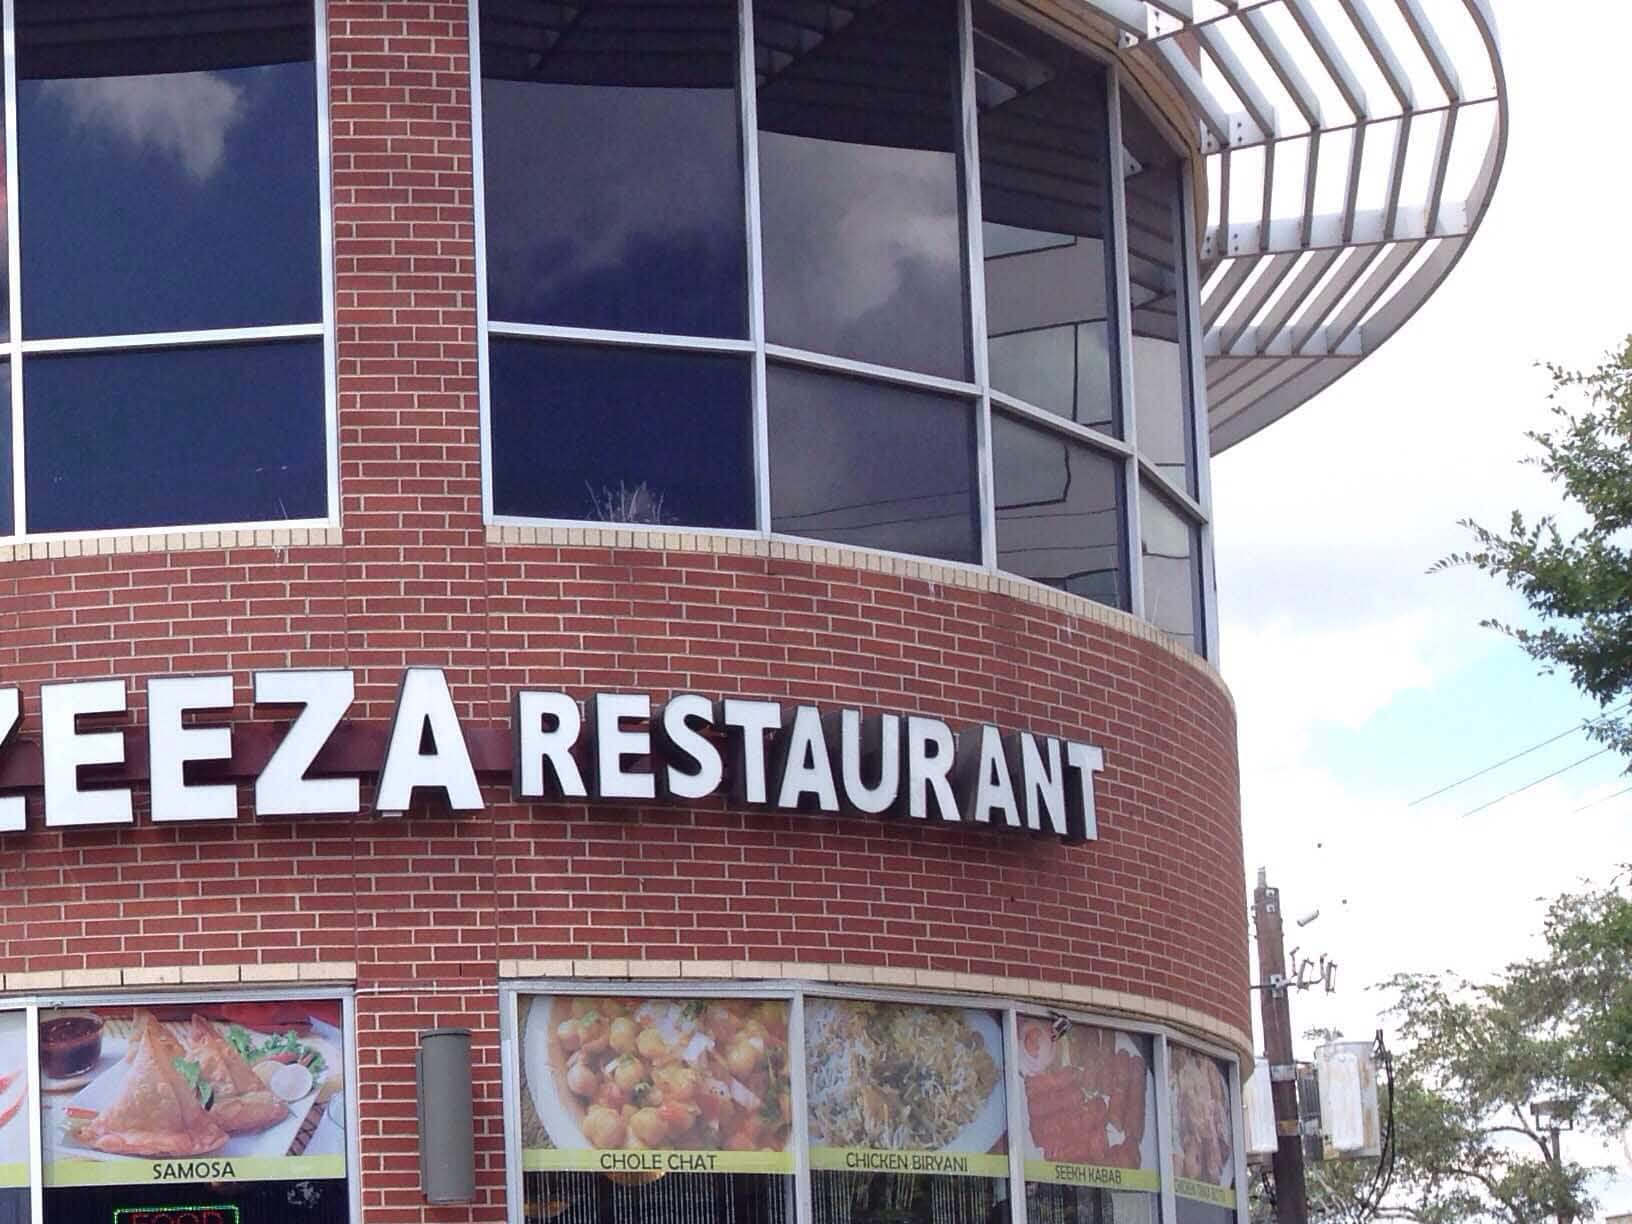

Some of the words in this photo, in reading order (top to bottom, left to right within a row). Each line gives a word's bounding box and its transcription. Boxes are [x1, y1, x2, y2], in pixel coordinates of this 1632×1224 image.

[516, 690, 1105, 841] RESTAURANT
[153, 1161, 236, 1180] SAMOSA
[599, 1153, 662, 1170] CHOLE
[667, 1154, 718, 1171] CHAT
[845, 1152, 908, 1169] CHICKEN
[911, 1155, 968, 1172] BIRYANI
[1055, 1165, 1086, 1182] SEEKH
[1088, 1168, 1122, 1185] KABAB
